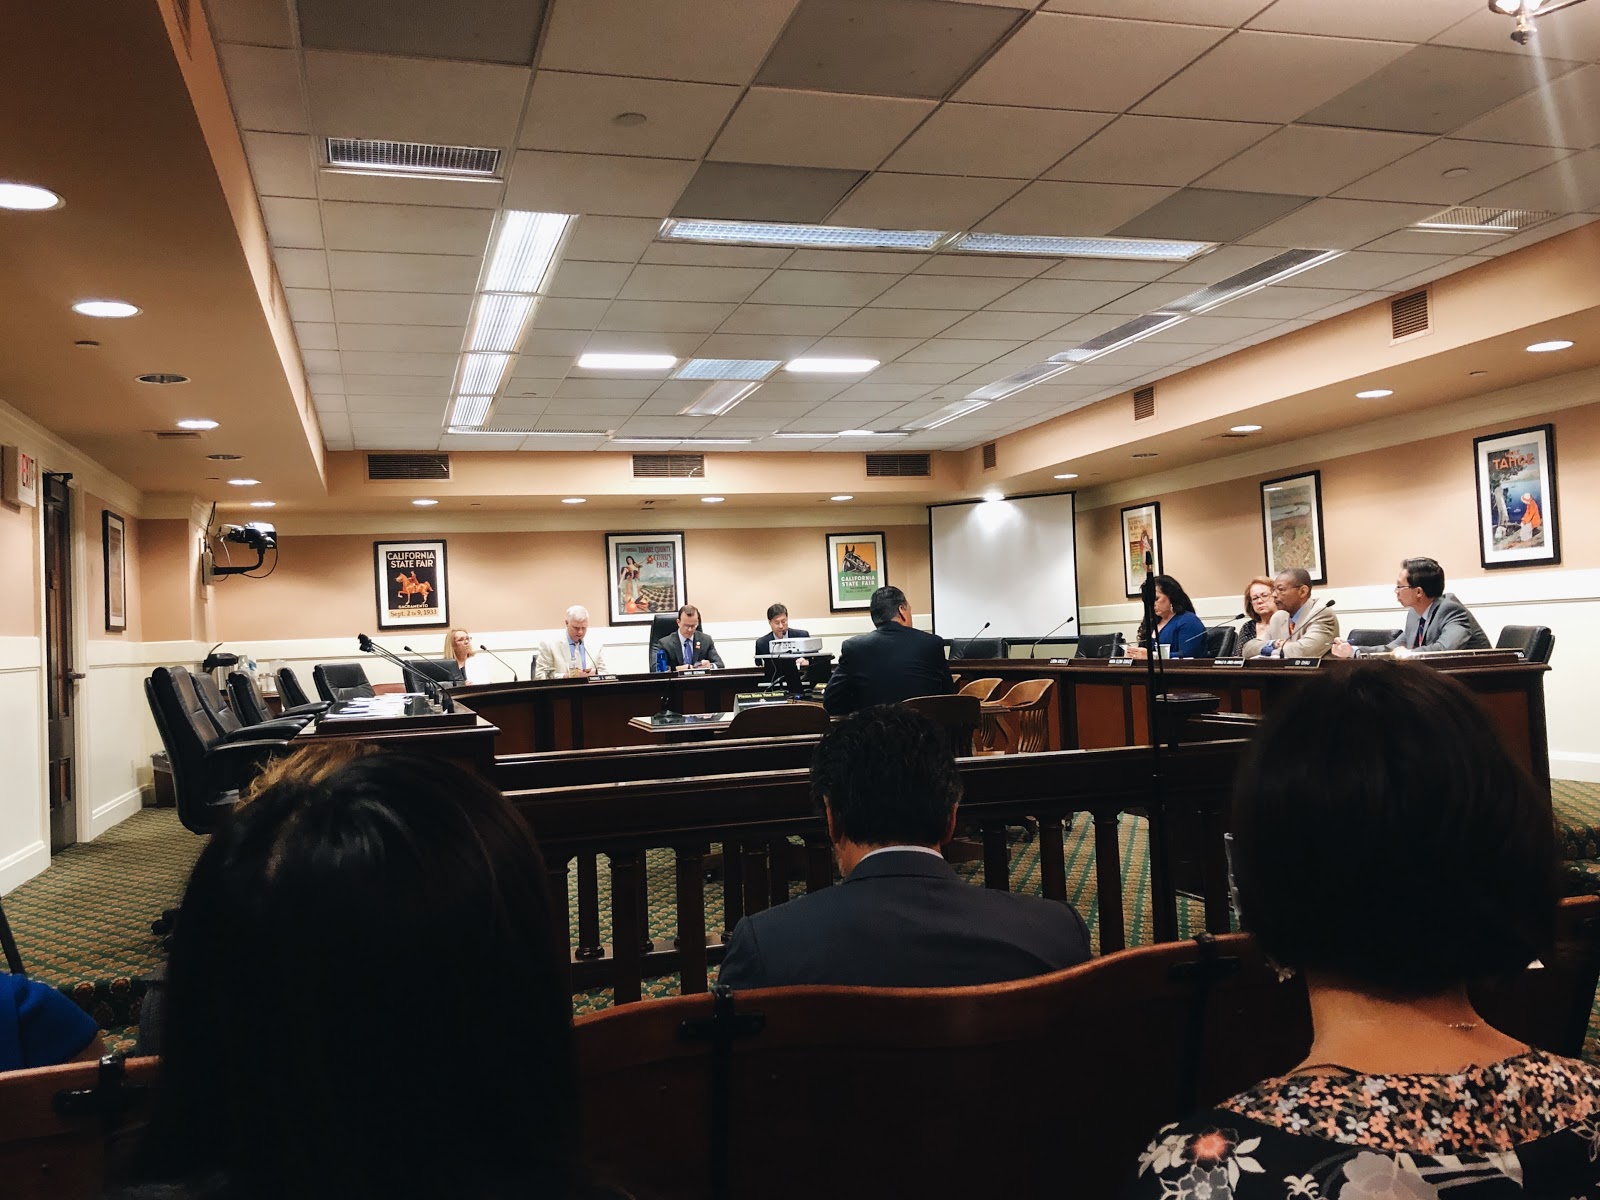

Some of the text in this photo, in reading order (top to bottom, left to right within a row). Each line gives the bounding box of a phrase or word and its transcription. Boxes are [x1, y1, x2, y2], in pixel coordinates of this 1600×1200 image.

[1493, 453, 1535, 470] TAHOE
[22, 453, 34, 490] EXIT
[387, 552, 435, 560] CALIFORNIA
[390, 560, 415, 568] STATE
